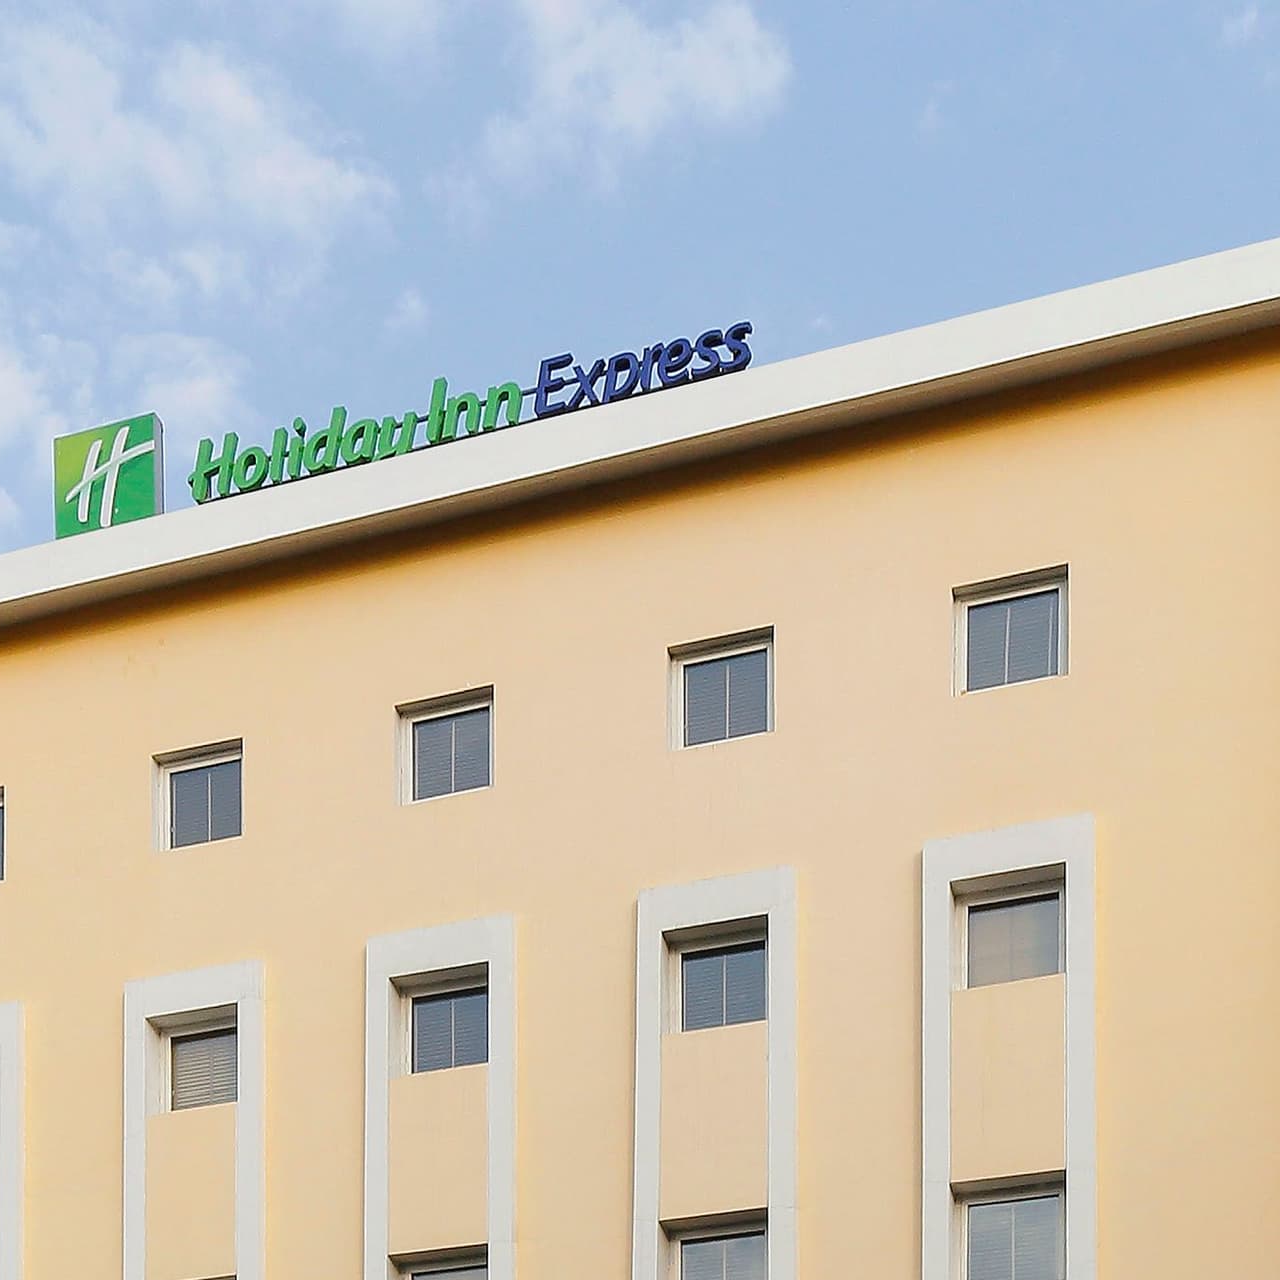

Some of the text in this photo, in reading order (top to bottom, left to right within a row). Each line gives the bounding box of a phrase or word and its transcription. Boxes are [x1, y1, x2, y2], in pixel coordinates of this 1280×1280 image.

[188, 321, 753, 504] Holiday Inn Express
